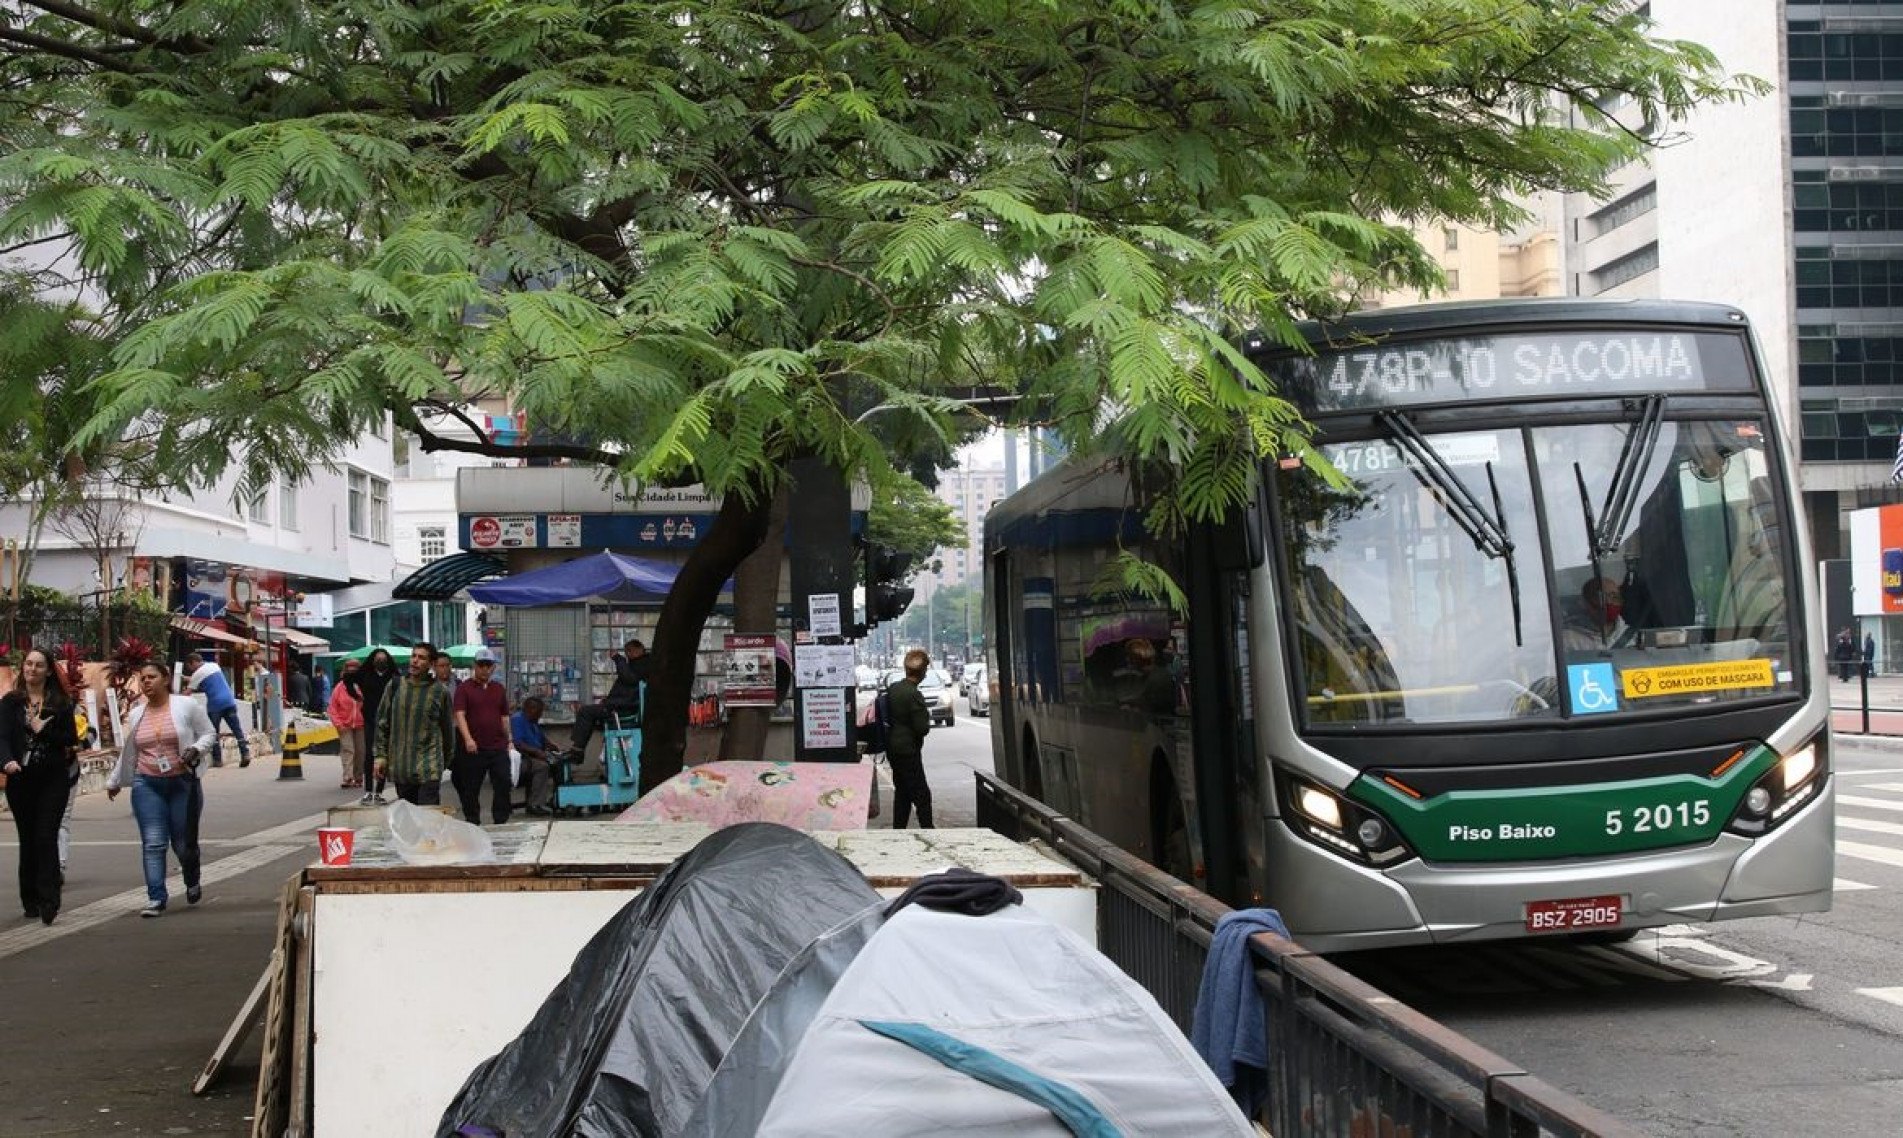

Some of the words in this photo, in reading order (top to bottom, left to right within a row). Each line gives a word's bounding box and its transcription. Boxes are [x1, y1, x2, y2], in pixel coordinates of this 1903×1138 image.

[1328, 346, 1497, 397] 478P-10
[1513, 335, 1694, 386] SACOMA
[1658, 679, 1683, 690] COM
[1684, 677, 1704, 688] USO
[1705, 675, 1720, 685] DE
[1605, 810, 1623, 835] 5
[1632, 800, 1711, 833] 2015
[1449, 824, 1492, 841] Piso
[1499, 823, 1556, 839] Baixo
[1532, 909, 1567, 928] BSZ
[1571, 906, 1618, 926] 2905
